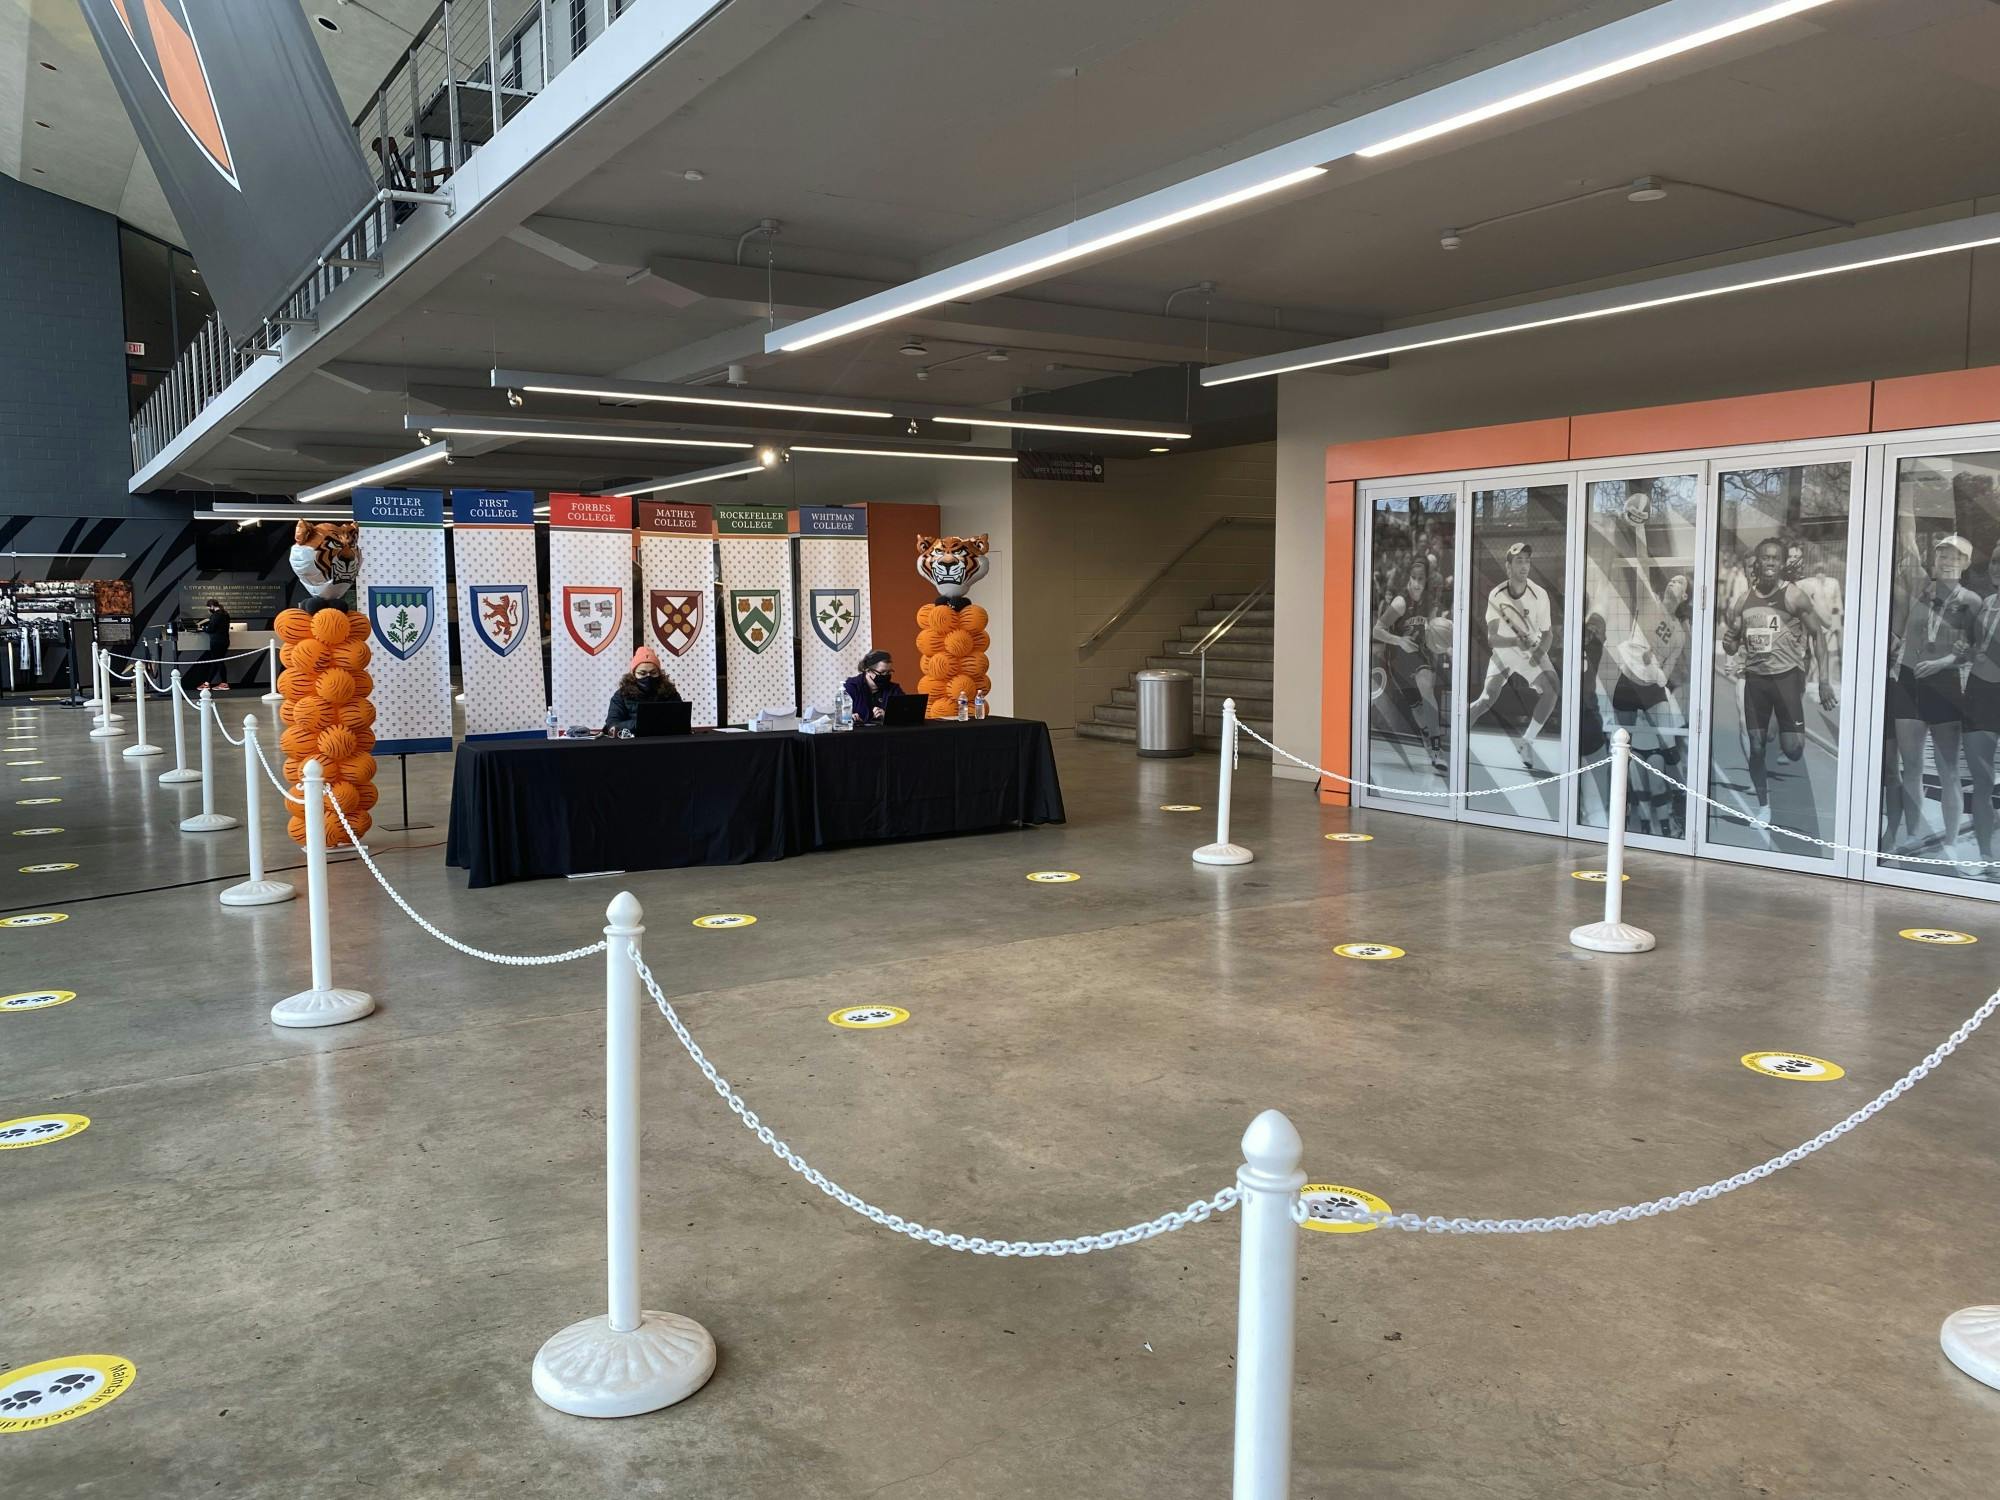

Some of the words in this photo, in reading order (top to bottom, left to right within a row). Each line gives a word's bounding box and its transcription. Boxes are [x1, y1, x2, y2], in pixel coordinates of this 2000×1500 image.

[375, 496, 422, 507] BUTLER
[478, 498, 509, 508] FIRST
[371, 506, 425, 517] COLLEGE
[469, 508, 519, 518] COLLEGE
[571, 502, 612, 513] FORBES
[567, 512, 616, 522] COLLEGE
[655, 508, 696, 519] MATHEY
[719, 511, 784, 520] ROCKEFELLER
[811, 512, 855, 522] WHITMAN
[653, 518, 698, 528] COLLEGE
[731, 520, 773, 529] COLLEGE
[813, 521, 853, 531] COLLEGE
[1769, 615, 1779, 631] 4
[1655, 621, 1672, 645] 22
[1318, 1185, 1374, 1202] distance
[89, 1363, 129, 1405] Maintain
[22, 1405, 88, 1429] social
